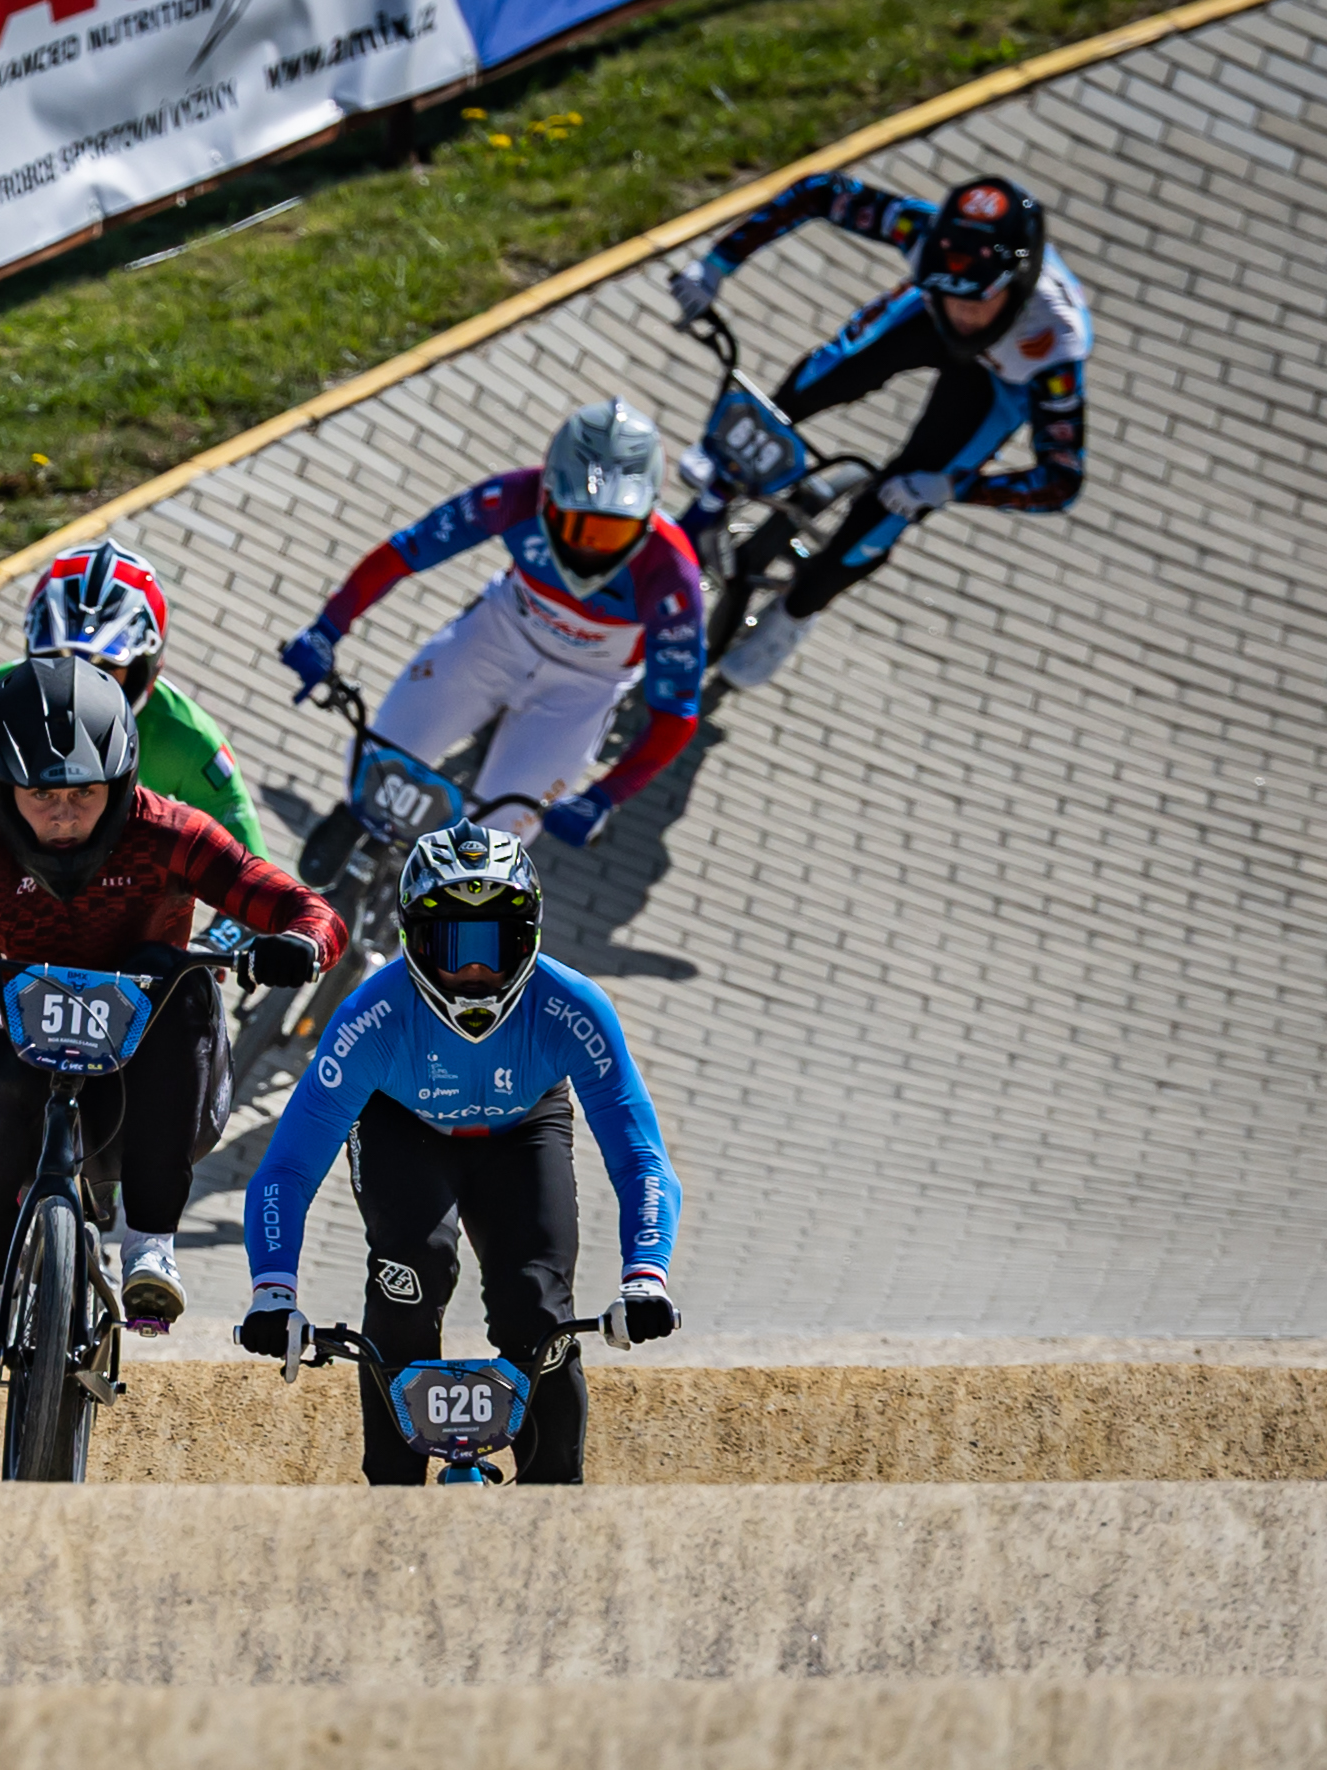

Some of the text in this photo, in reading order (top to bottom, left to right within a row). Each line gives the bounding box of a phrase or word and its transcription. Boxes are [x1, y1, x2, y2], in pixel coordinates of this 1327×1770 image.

[48, 766, 84, 777] BELL
[41, 993, 110, 1040] 518
[333, 999, 393, 1058] allwyn
[428, 1384, 493, 1424] 626
